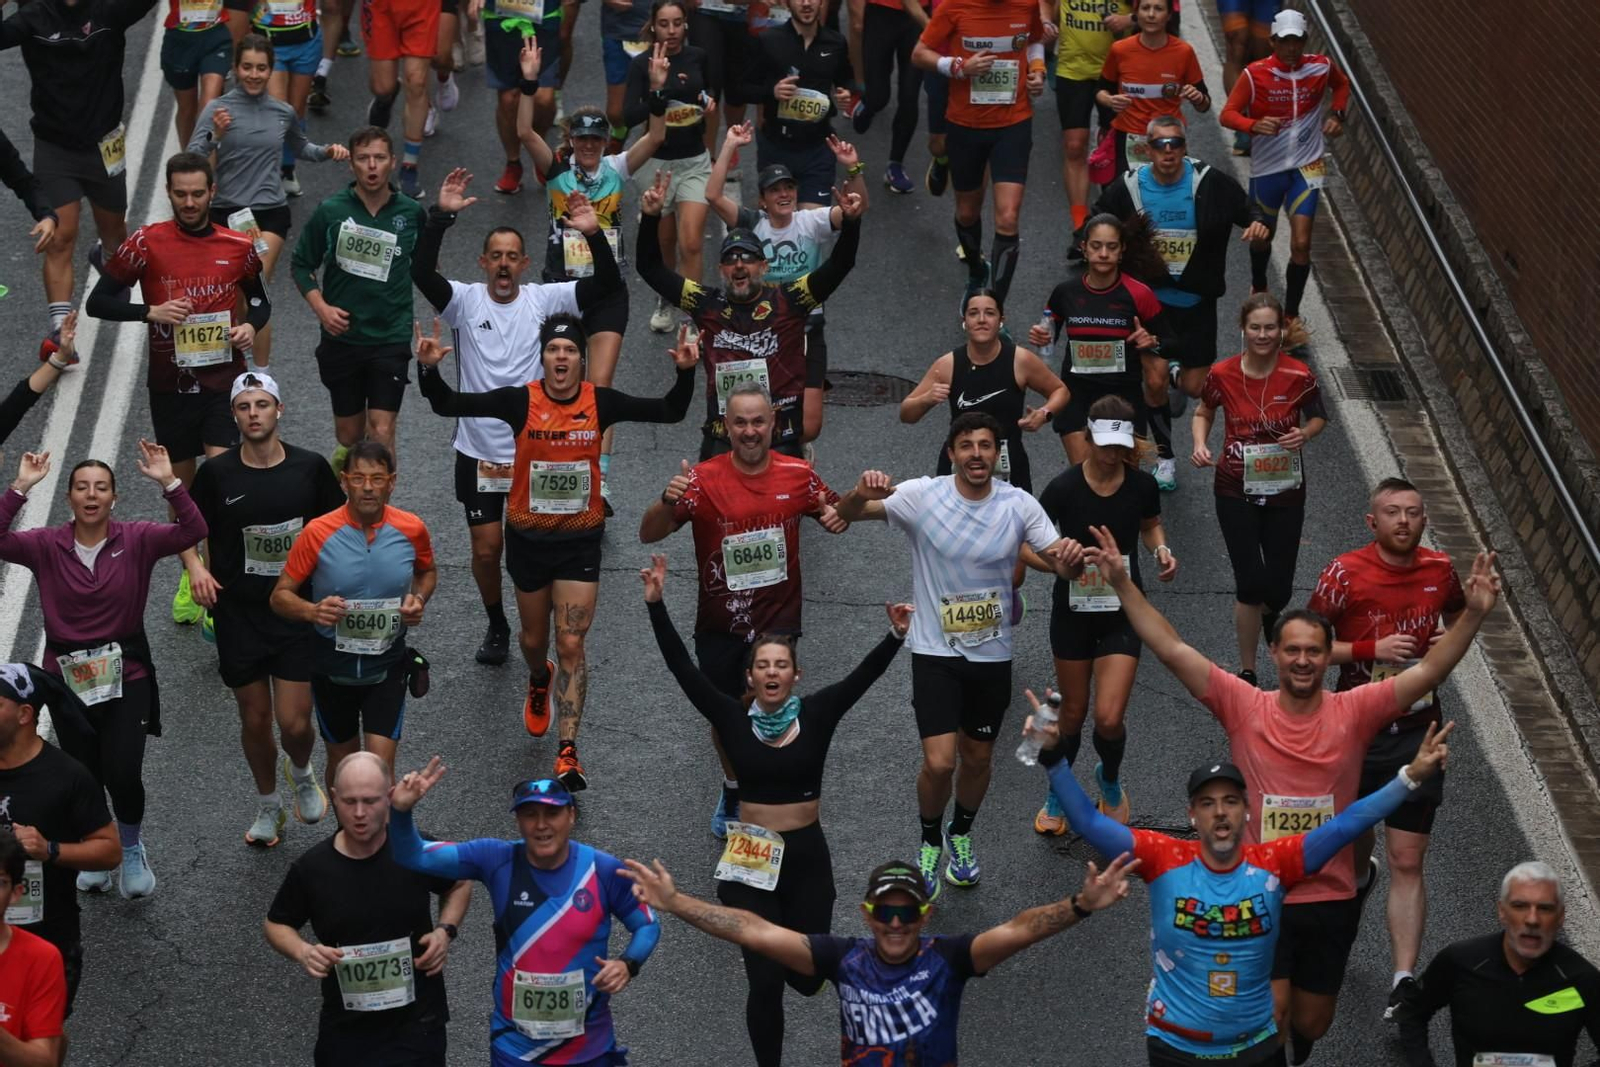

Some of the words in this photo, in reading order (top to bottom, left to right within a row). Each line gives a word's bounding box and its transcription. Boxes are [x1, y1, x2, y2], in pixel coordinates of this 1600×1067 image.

[1065, 13, 1107, 32] Runn
[978, 71, 1009, 85] 8265
[784, 98, 821, 115] 14650
[346, 236, 382, 257] 9829
[1068, 316, 1127, 326] PRORUNNERS
[180, 325, 223, 345] 11672
[1077, 344, 1112, 359] 8052
[528, 430, 567, 441] NEVER
[1253, 457, 1289, 474] 9622
[539, 475, 578, 491] 7529
[253, 535, 292, 554] 7880
[733, 543, 773, 565] 6848
[345, 613, 387, 630] 6640
[946, 602, 995, 625] 14490
[1268, 811, 1322, 831] 12321
[729, 835, 772, 862] 12444
[342, 957, 402, 982] 10273
[523, 989, 569, 1011] 6738
[841, 990, 938, 1046] SEVILLA
